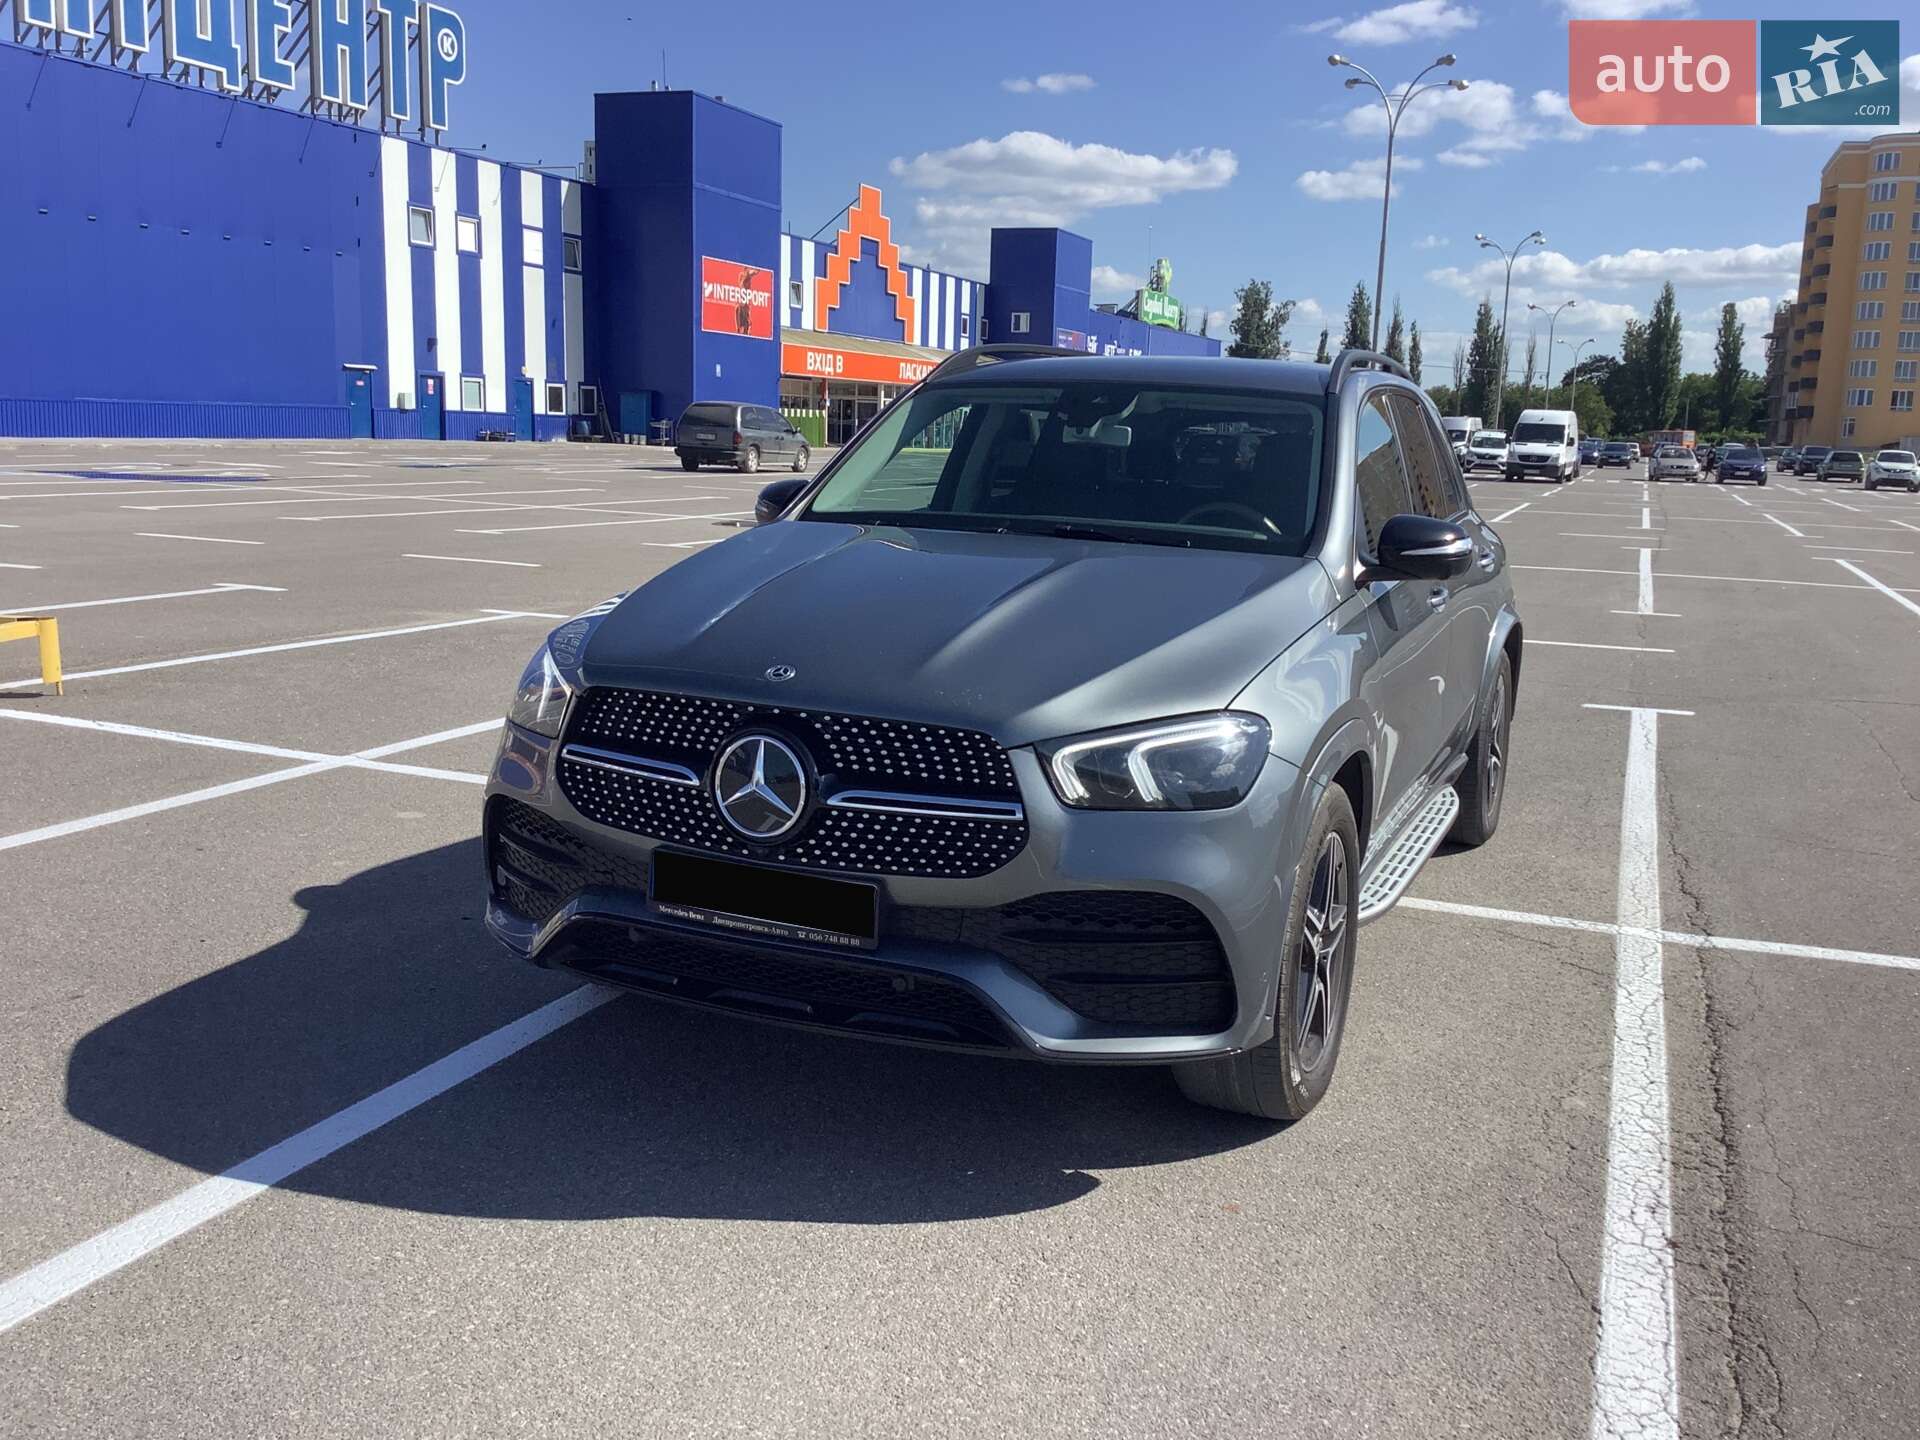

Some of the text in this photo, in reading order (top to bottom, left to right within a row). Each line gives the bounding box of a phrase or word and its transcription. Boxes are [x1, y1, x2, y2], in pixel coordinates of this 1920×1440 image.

[713, 282, 771, 308] INTERSPORT
[806, 351, 835, 376] ВХІД
[658, 904, 705, 921] Mercedes Benz
